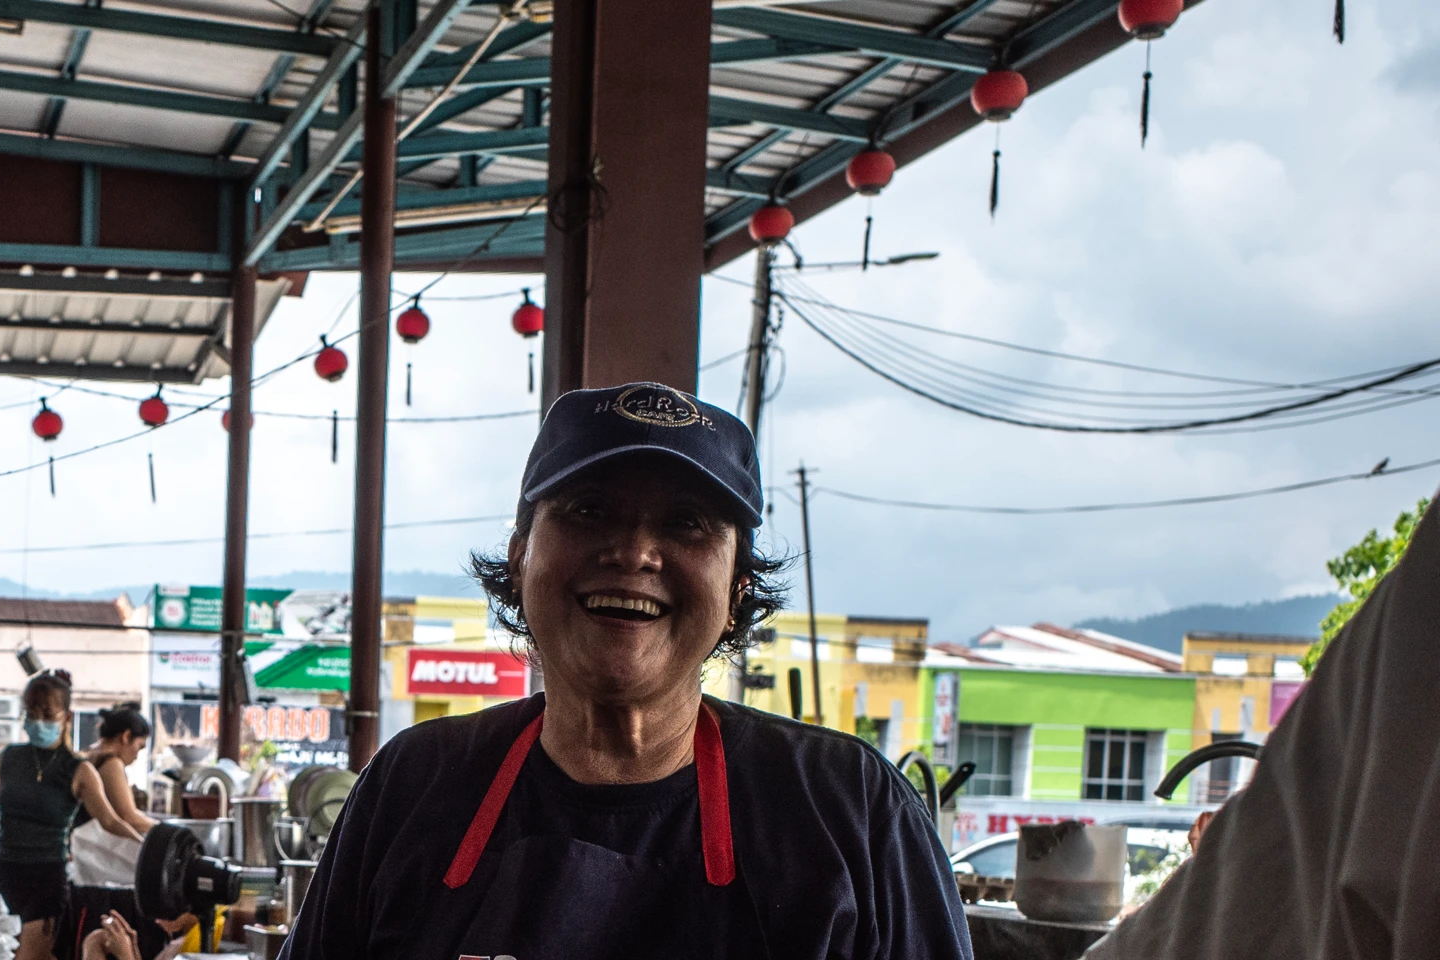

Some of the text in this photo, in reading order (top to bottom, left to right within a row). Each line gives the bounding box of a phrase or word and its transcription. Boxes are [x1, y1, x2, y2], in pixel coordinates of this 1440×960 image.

[594, 395, 652, 414] Hard
[411, 660, 498, 684] MOTUL
[200, 705, 331, 743] KRADO
